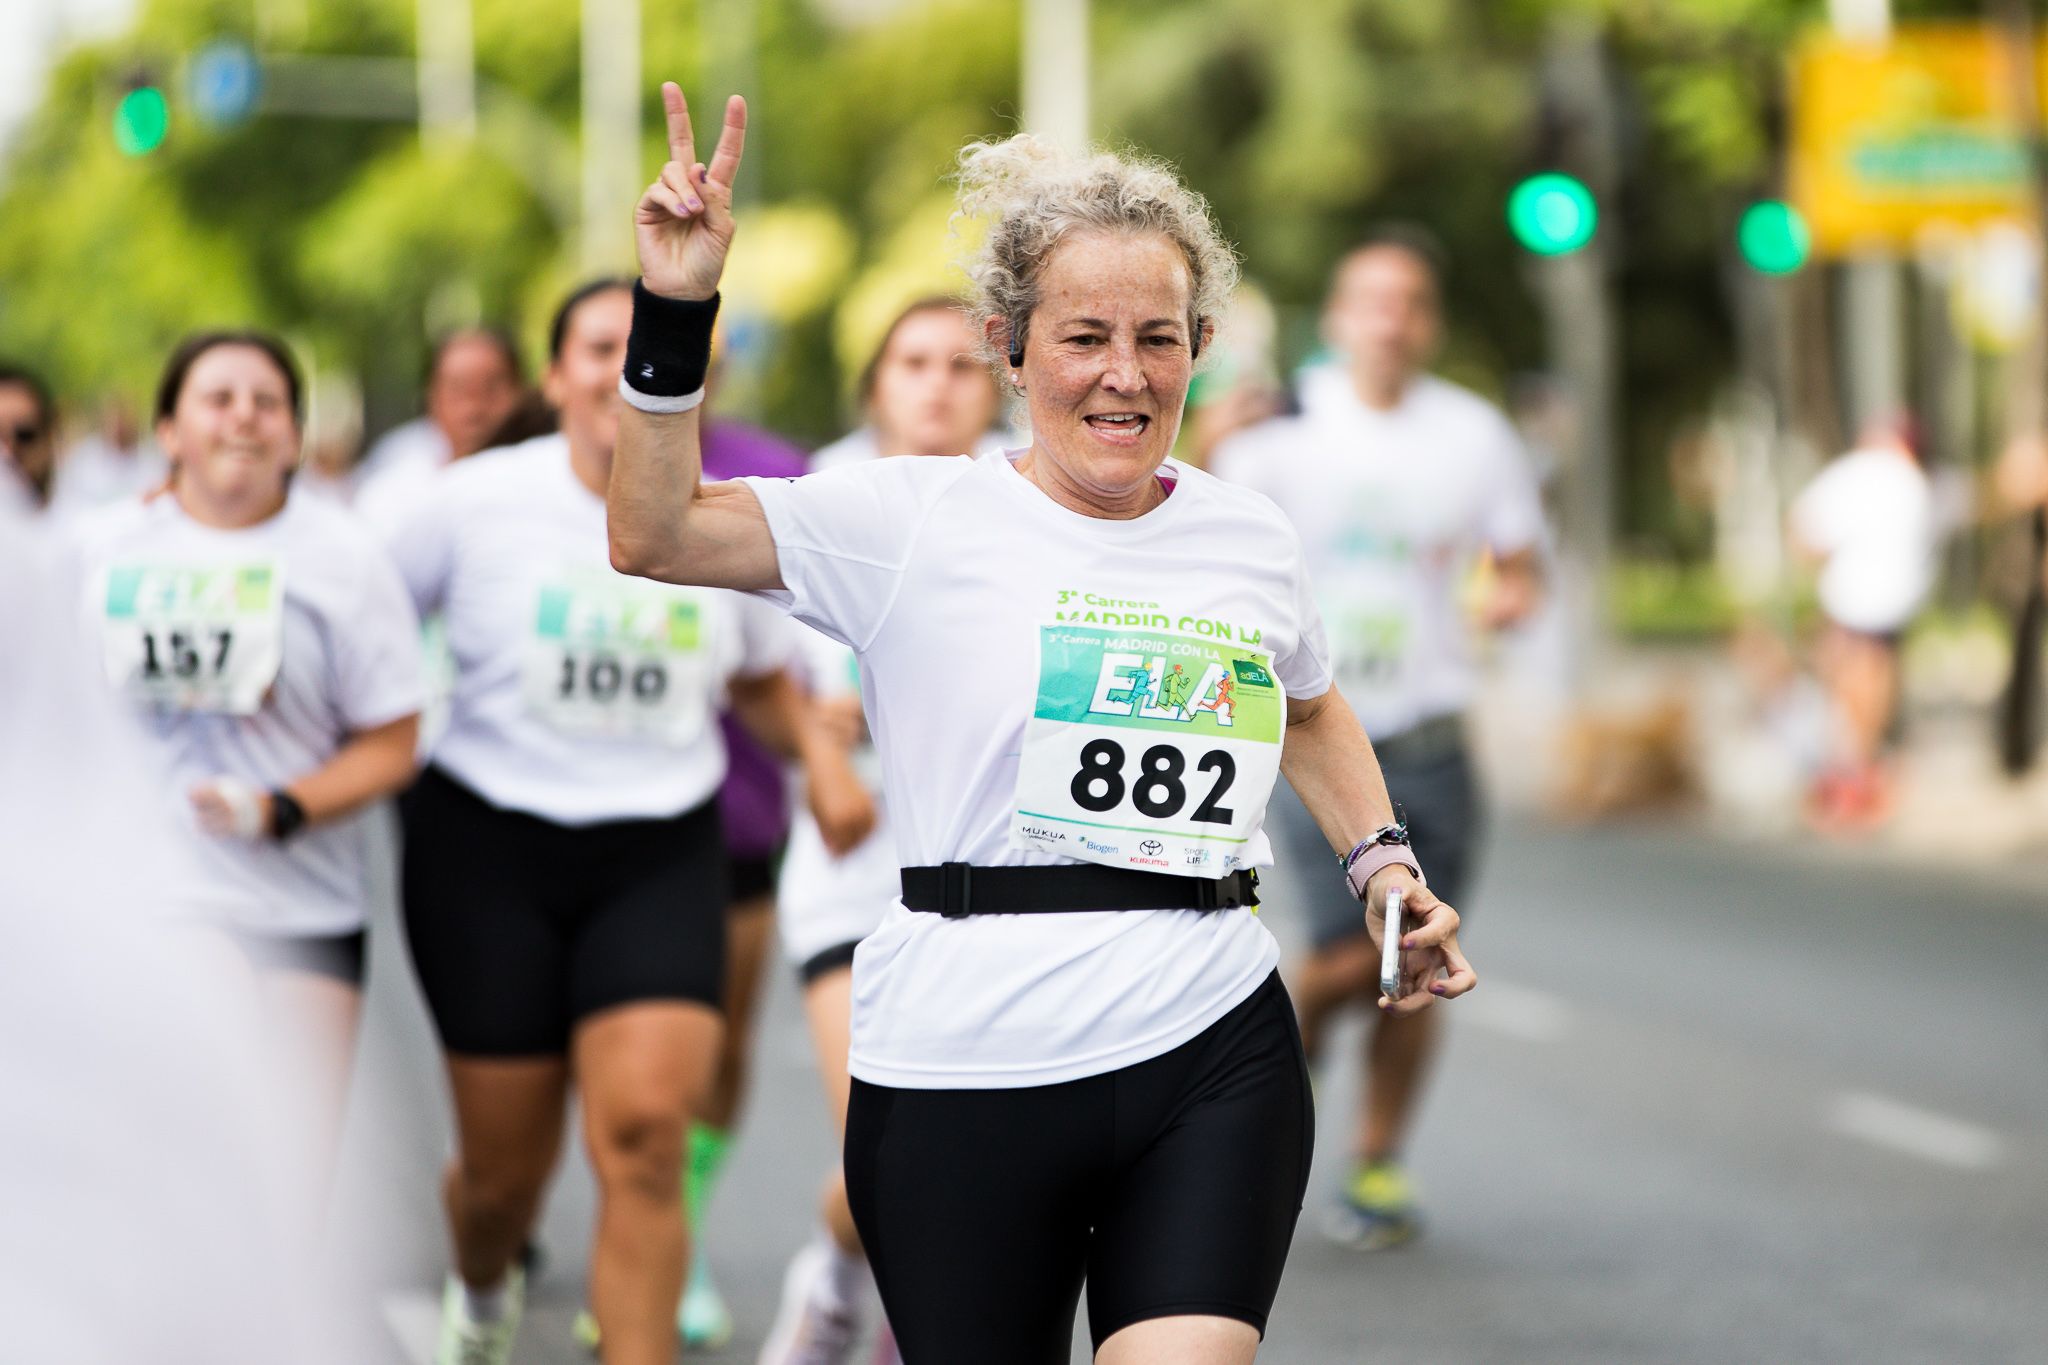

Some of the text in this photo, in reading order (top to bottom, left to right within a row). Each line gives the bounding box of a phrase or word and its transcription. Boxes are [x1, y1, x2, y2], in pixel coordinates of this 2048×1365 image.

[1084, 593, 1159, 609] Carrera
[1178, 616, 1232, 640] CON
[143, 627, 232, 679] 157
[1062, 634, 1101, 646] Carrera
[1103, 637, 1168, 653] MADRID
[1170, 643, 1201, 657] CON
[1205, 648, 1220, 660] LA
[559, 653, 668, 704] 100
[1088, 652, 1233, 727] ELA
[1240, 671, 1270, 684] adELA
[1070, 738, 1236, 825] 882
[1022, 826, 1067, 840] MUKUA
[1086, 841, 1119, 854] Biogen
